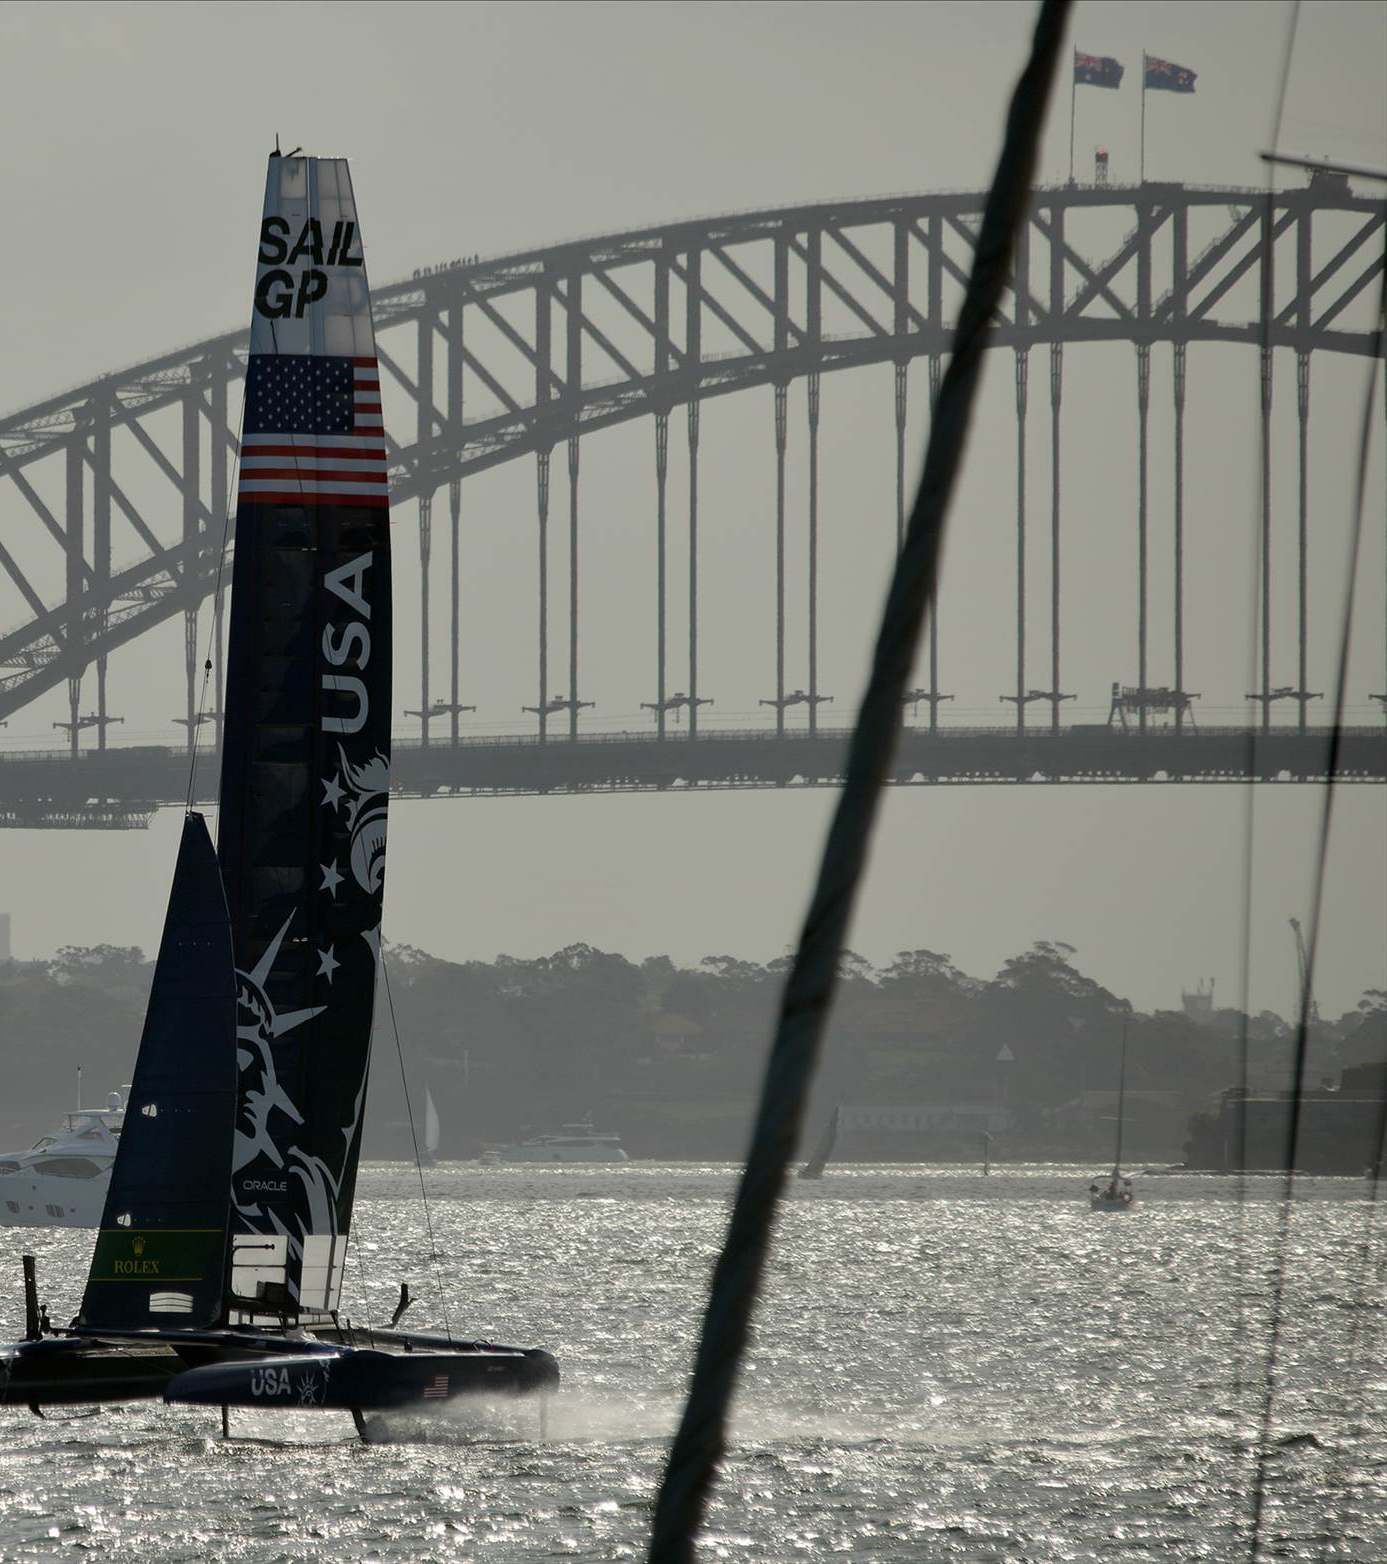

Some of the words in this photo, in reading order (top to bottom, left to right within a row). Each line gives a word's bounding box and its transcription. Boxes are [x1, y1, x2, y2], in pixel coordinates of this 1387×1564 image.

[258, 216, 363, 267] SAIL
[254, 269, 328, 319] GP
[321, 550, 373, 734] USA
[243, 1180, 287, 1191] ORACLE
[114, 1260, 160, 1274] ROLEX
[251, 1368, 291, 1396] USA
